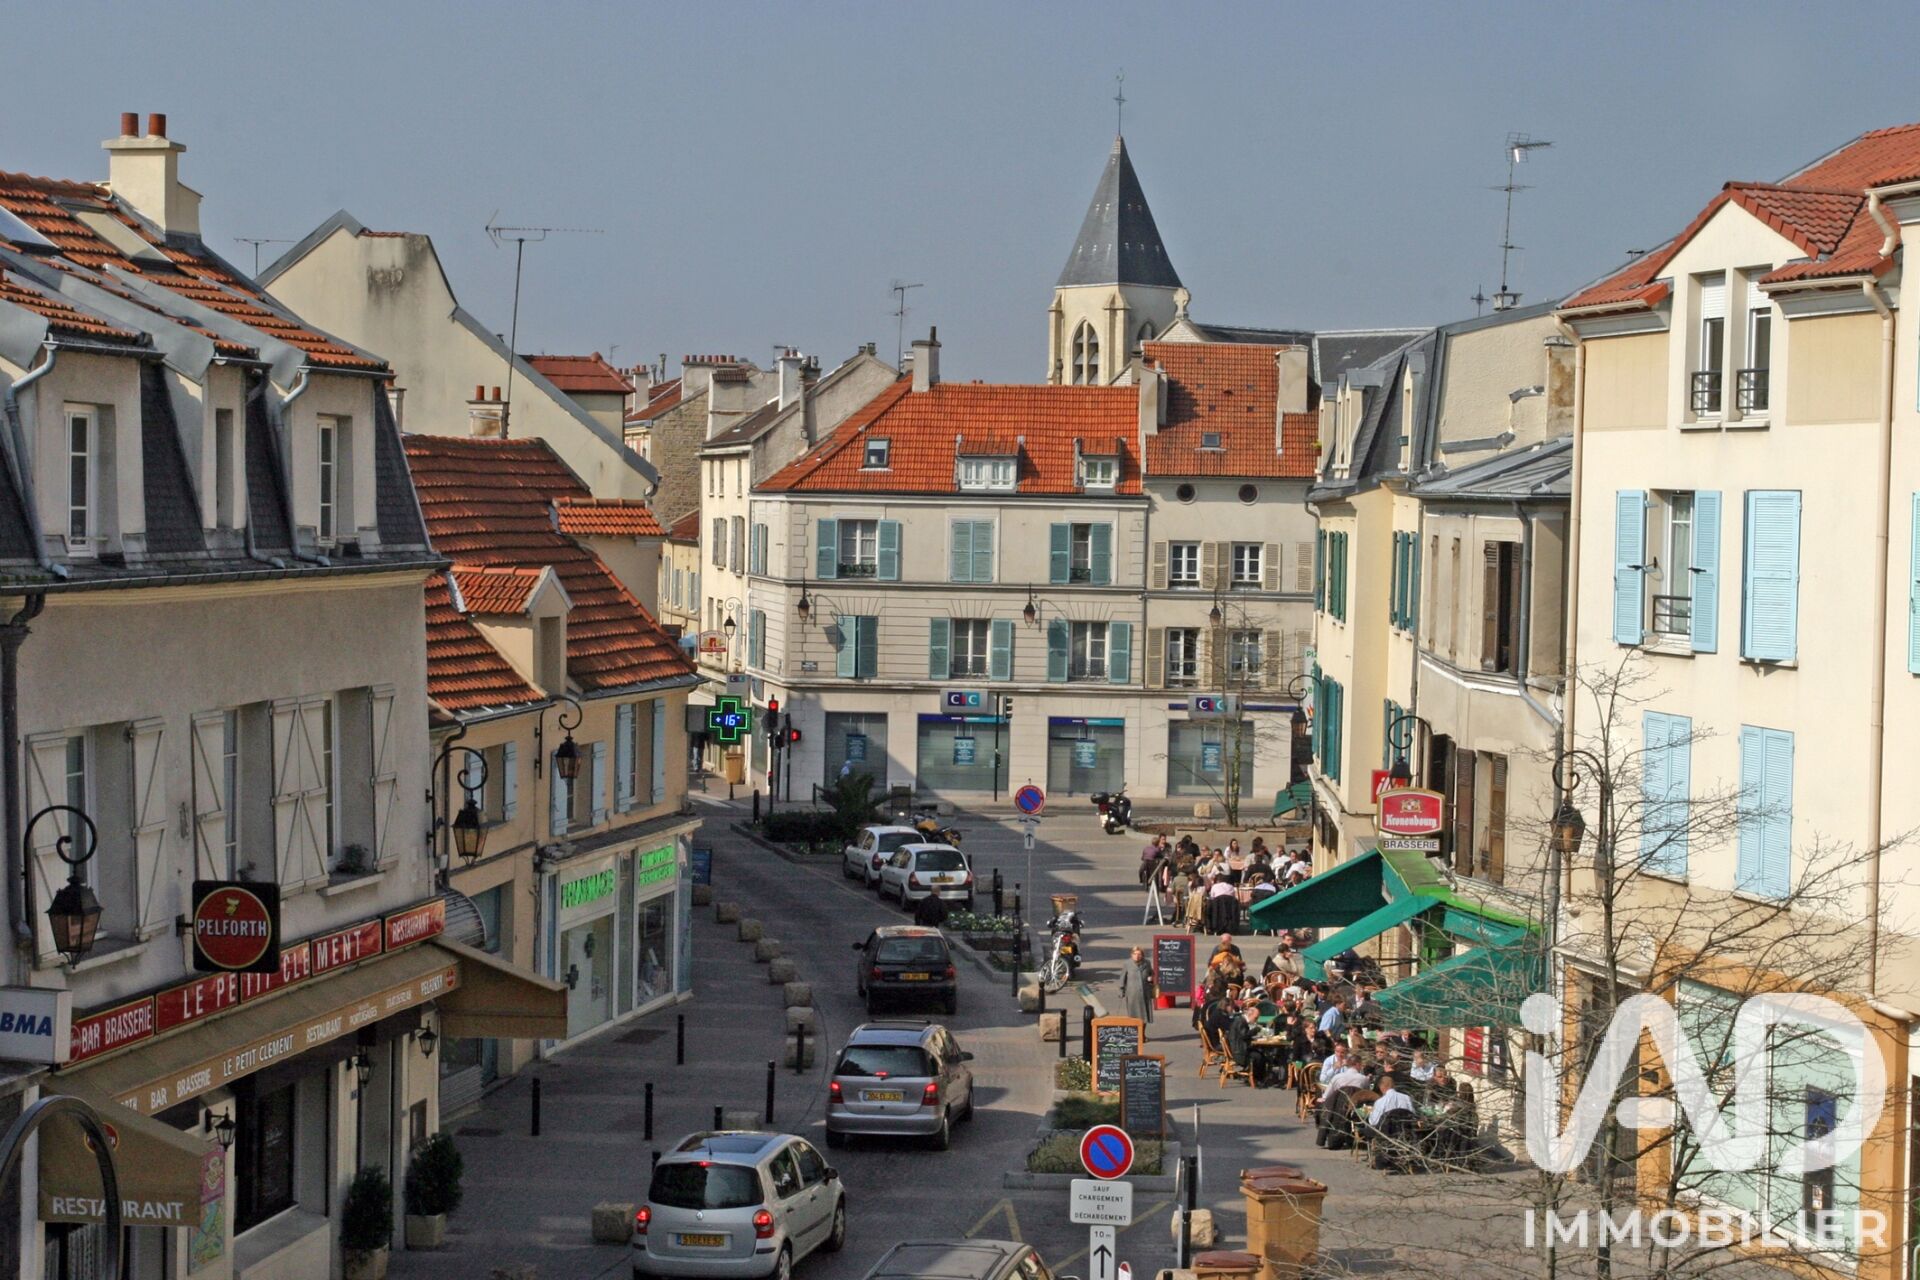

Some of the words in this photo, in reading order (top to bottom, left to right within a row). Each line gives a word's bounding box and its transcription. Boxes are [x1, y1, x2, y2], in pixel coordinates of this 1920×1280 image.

[1385, 814, 1437, 829] Kronenbourg
[1383, 840, 1437, 849] BRASSERIE
[197, 918, 267, 937] PELFORTH
[392, 911, 430, 944] RESTAURANT
[183, 984, 204, 1019] LE
[283, 930, 361, 983] CLEMENT
[0, 1012, 52, 1037] BMA
[81, 1022, 100, 1053] BAR
[105, 1004, 152, 1045] BRASSERIE
[151, 1087, 168, 1109] BAR
[176, 1068, 212, 1098] BRASSERIE
[223, 1058, 233, 1077] LE
[235, 1048, 257, 1072] PETIT
[259, 1034, 295, 1062] CLEMENT
[306, 1016, 343, 1043] RESTAURANT
[1078, 1194, 1124, 1203] CHARGEMENT
[1074, 1211, 1127, 1221] DÉCHARGEMENT
